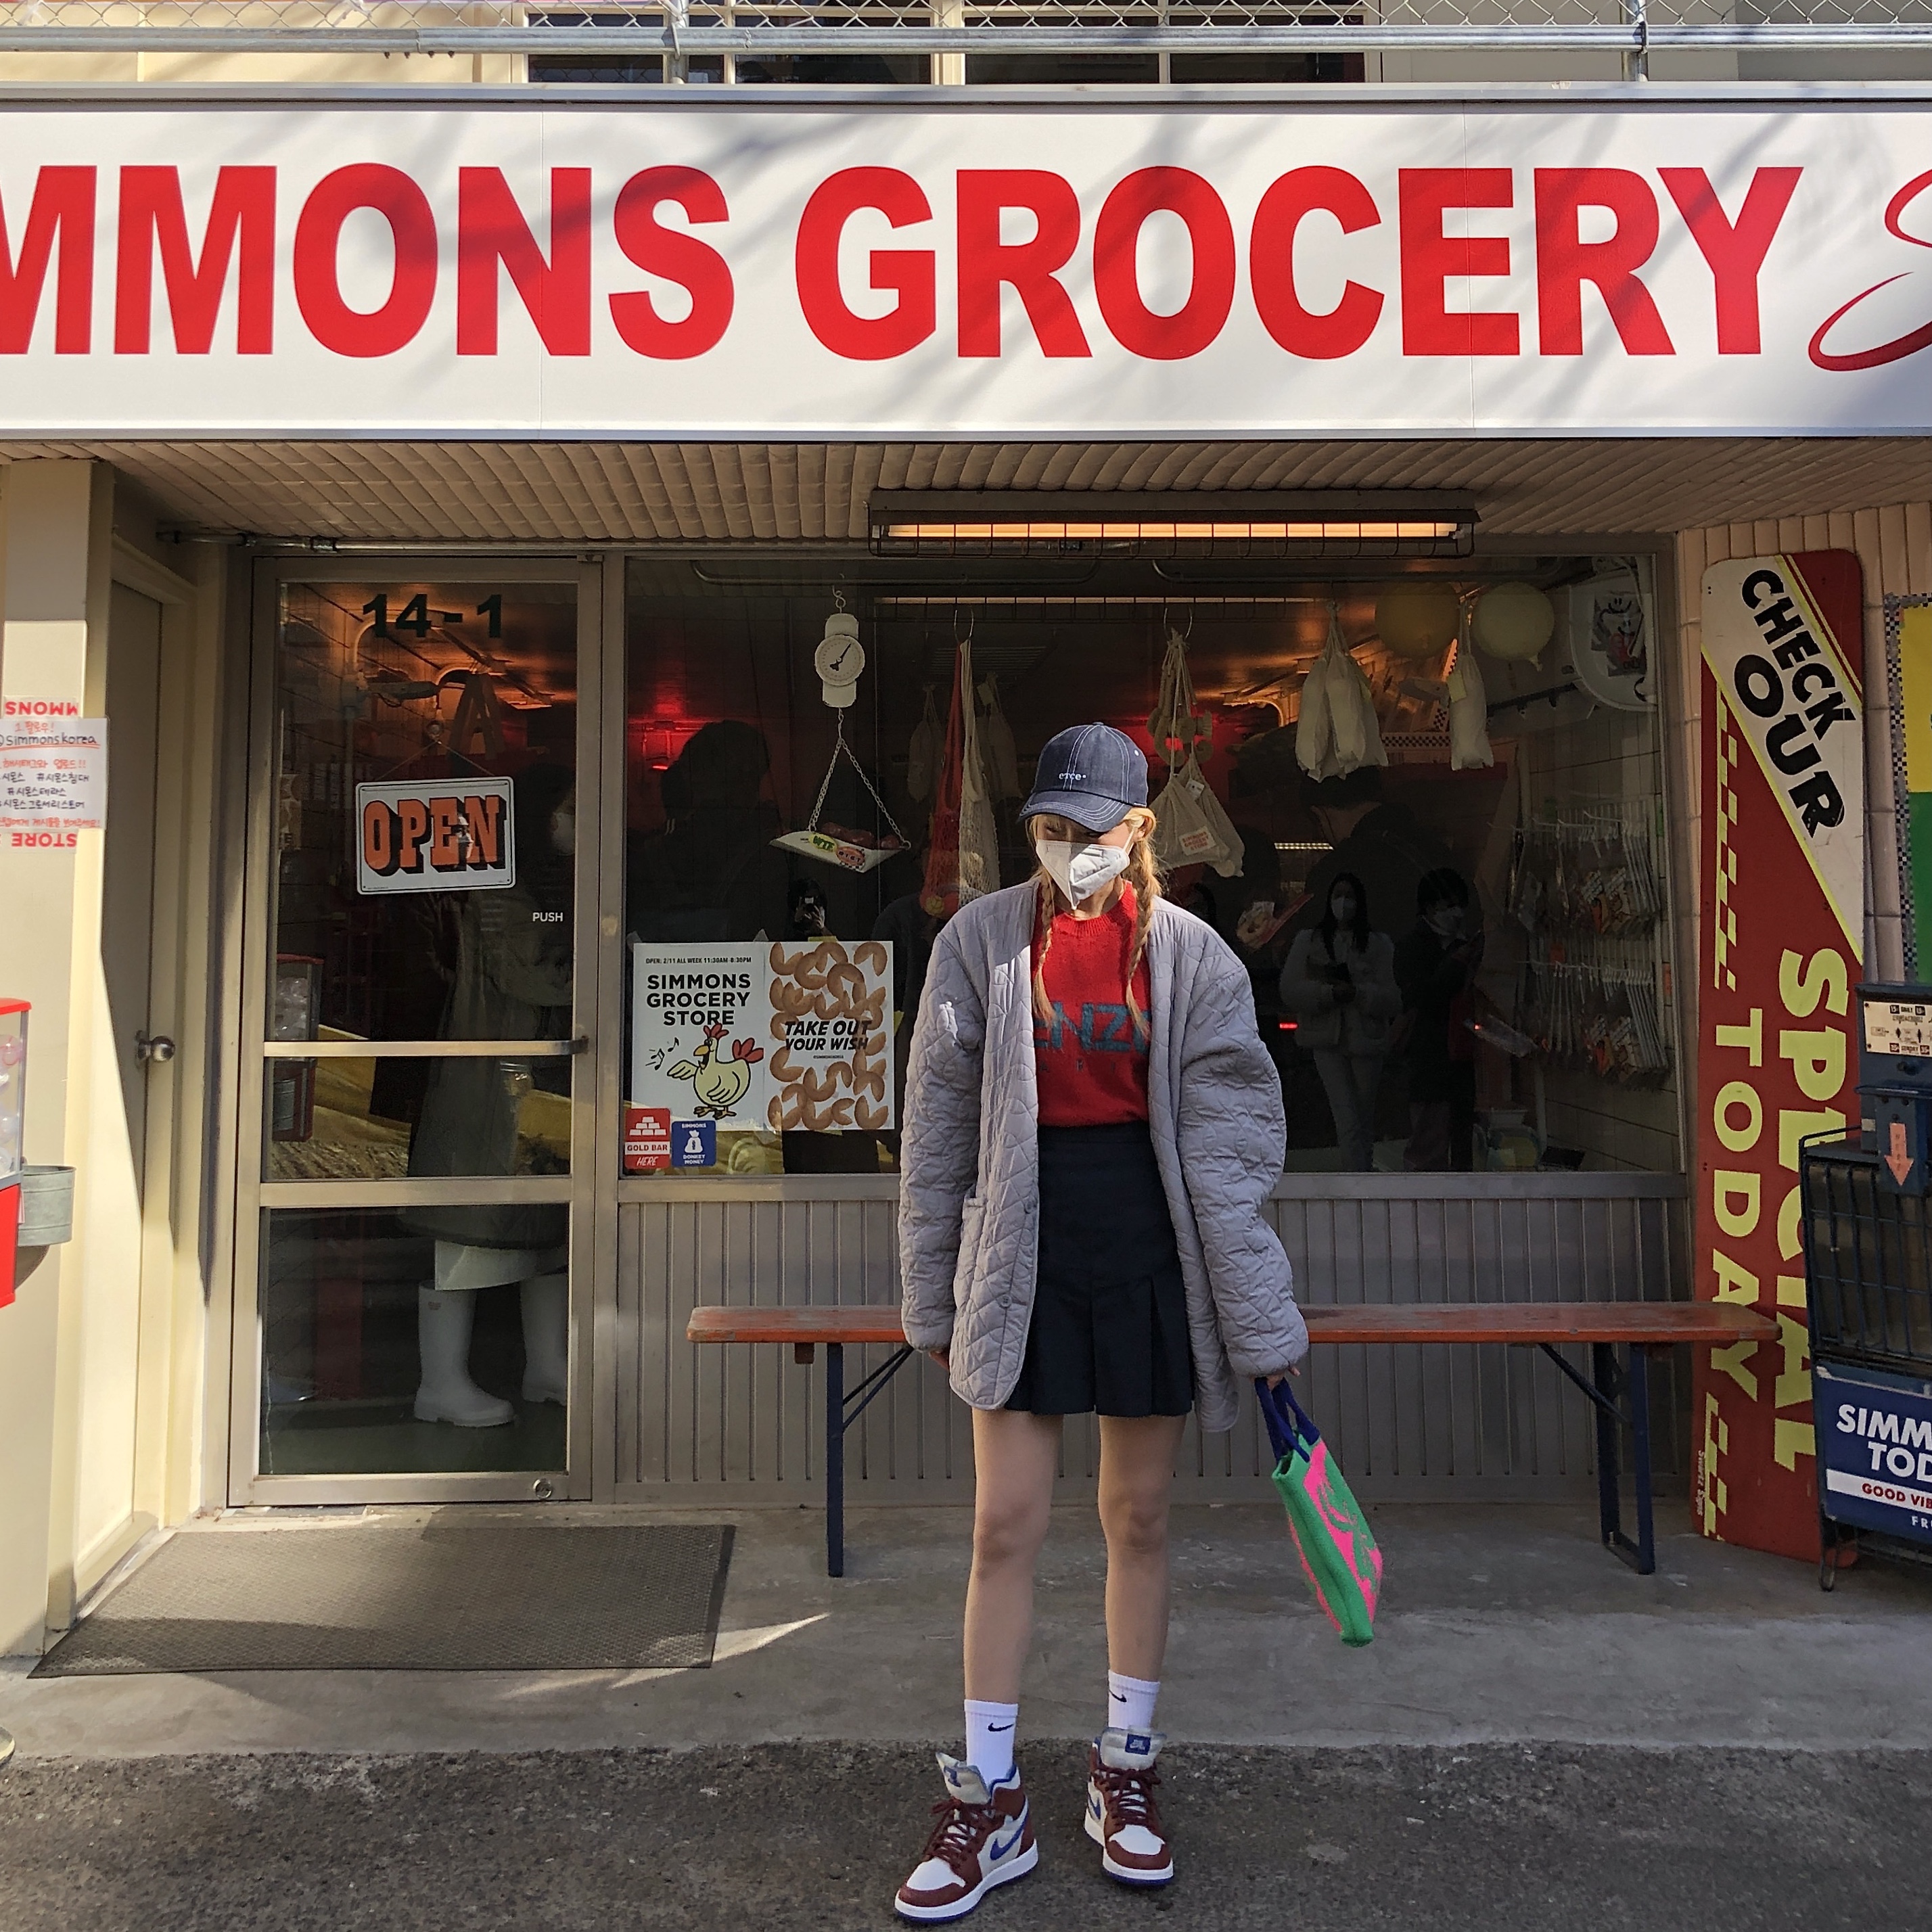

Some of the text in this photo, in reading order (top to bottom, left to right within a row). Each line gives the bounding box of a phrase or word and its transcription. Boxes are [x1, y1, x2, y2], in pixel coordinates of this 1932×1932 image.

[796, 166, 1803, 361] GROCERY
[1742, 570, 1856, 741] CHECK
[1734, 654, 1847, 839] OUR
[0, 771, 89, 784] 시몬스 #시몬스침대
[0, 798, 85, 810] 시몬스그로서리스토어
[11, 833, 78, 847] STORE
[363, 795, 507, 877] OPEN
[532, 911, 564, 923] PUSH
[647, 973, 751, 990] SIMMONS
[647, 991, 751, 1008] GROCERY
[663, 1010, 735, 1026] STORE
[785, 1020, 873, 1036] TAKE OUT
[785, 1037, 869, 1051] YOUR WISH
[637, 1156, 659, 1166] HERE
[1711, 1008, 1763, 1402] TODAY
[1837, 1404, 1932, 1451] SIMM
[1862, 1483, 1906, 1502] GOOD
[1912, 1516, 1932, 1530] FR
